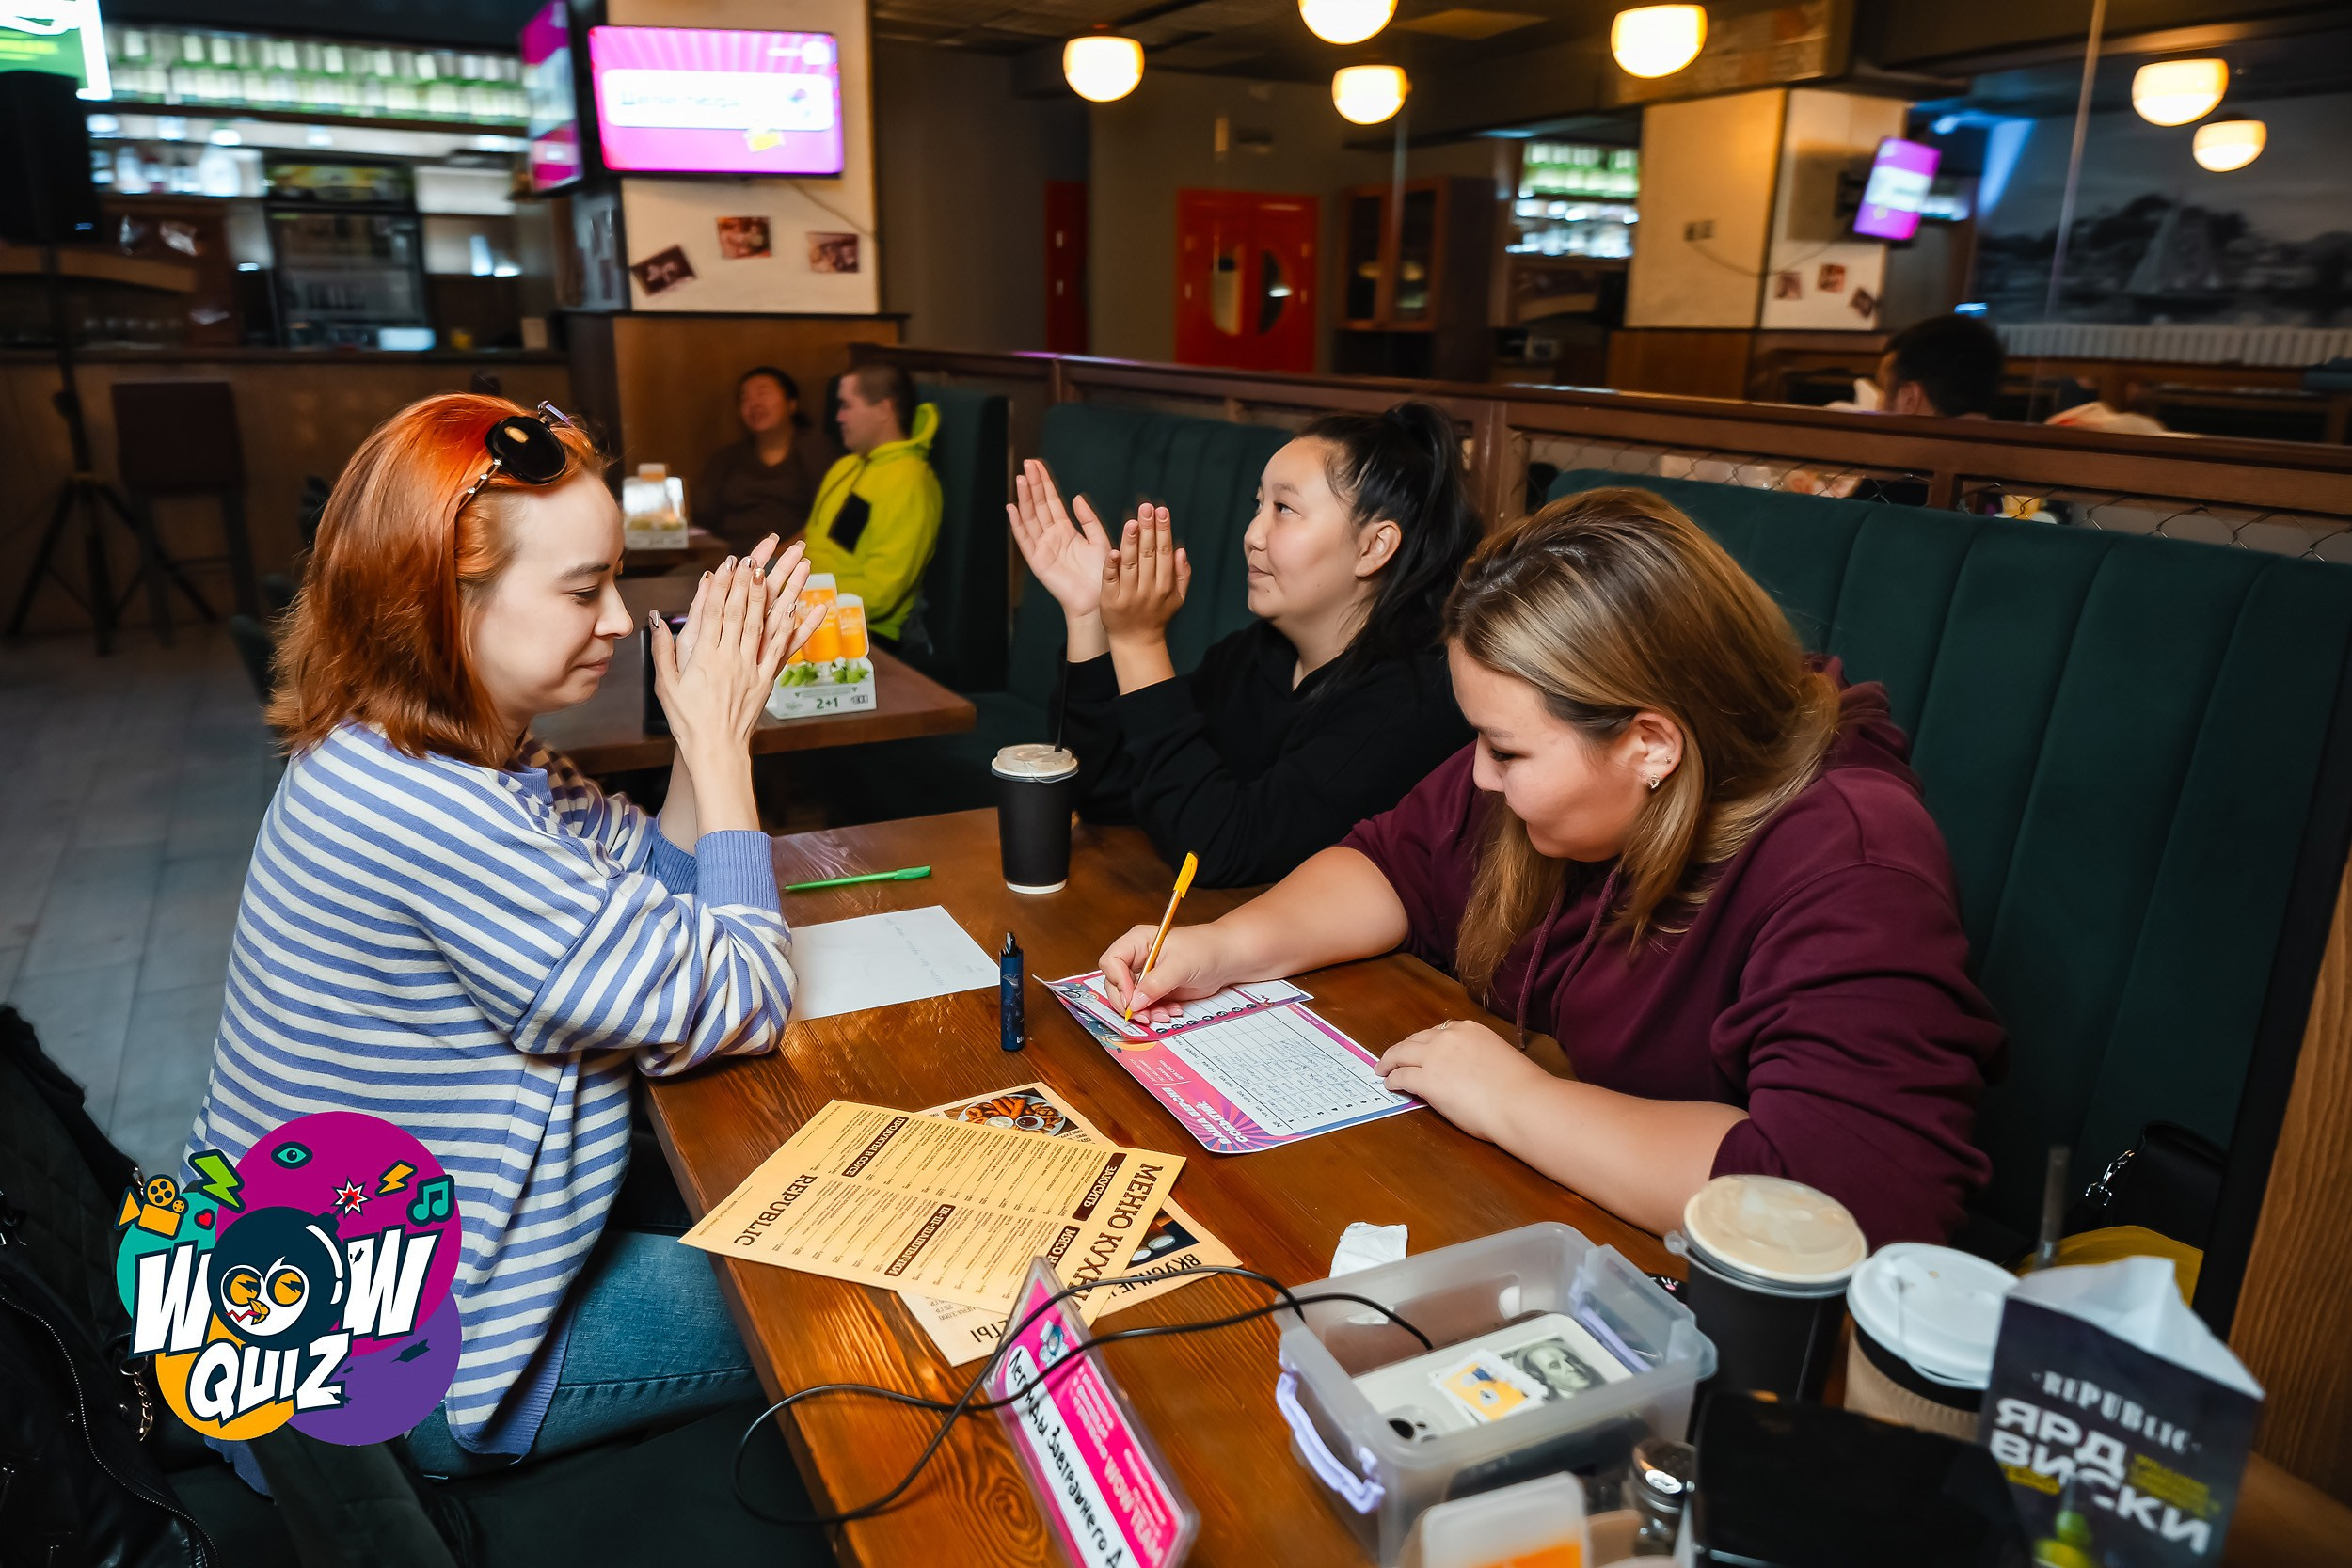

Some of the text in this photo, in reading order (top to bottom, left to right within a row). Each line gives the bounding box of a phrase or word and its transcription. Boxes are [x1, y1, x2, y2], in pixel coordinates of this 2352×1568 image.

[866, 1117, 906, 1151] ПРОДУКТЫ
[1161, 1086, 1232, 1144] ВАША ВЕРСИЯ
[844, 1155, 870, 1176] СОУСЕ
[1080, 1164, 1118, 1208] ЗАКУСИТЬ
[1103, 1163, 1165, 1230] МЕНЮ
[731, 1173, 818, 1246] REPUBLIC
[886, 1205, 952, 1275] Ш-Ш-ШАШЛЫЧКИ
[1049, 1227, 1076, 1255] МЯСО
[1008, 1348, 1044, 1436] Легнды
[2042, 1370, 2192, 1456] REPUBLIC
[1994, 1397, 2128, 1482] ЯРД
[1990, 1429, 2213, 1555] ВИСКИ
